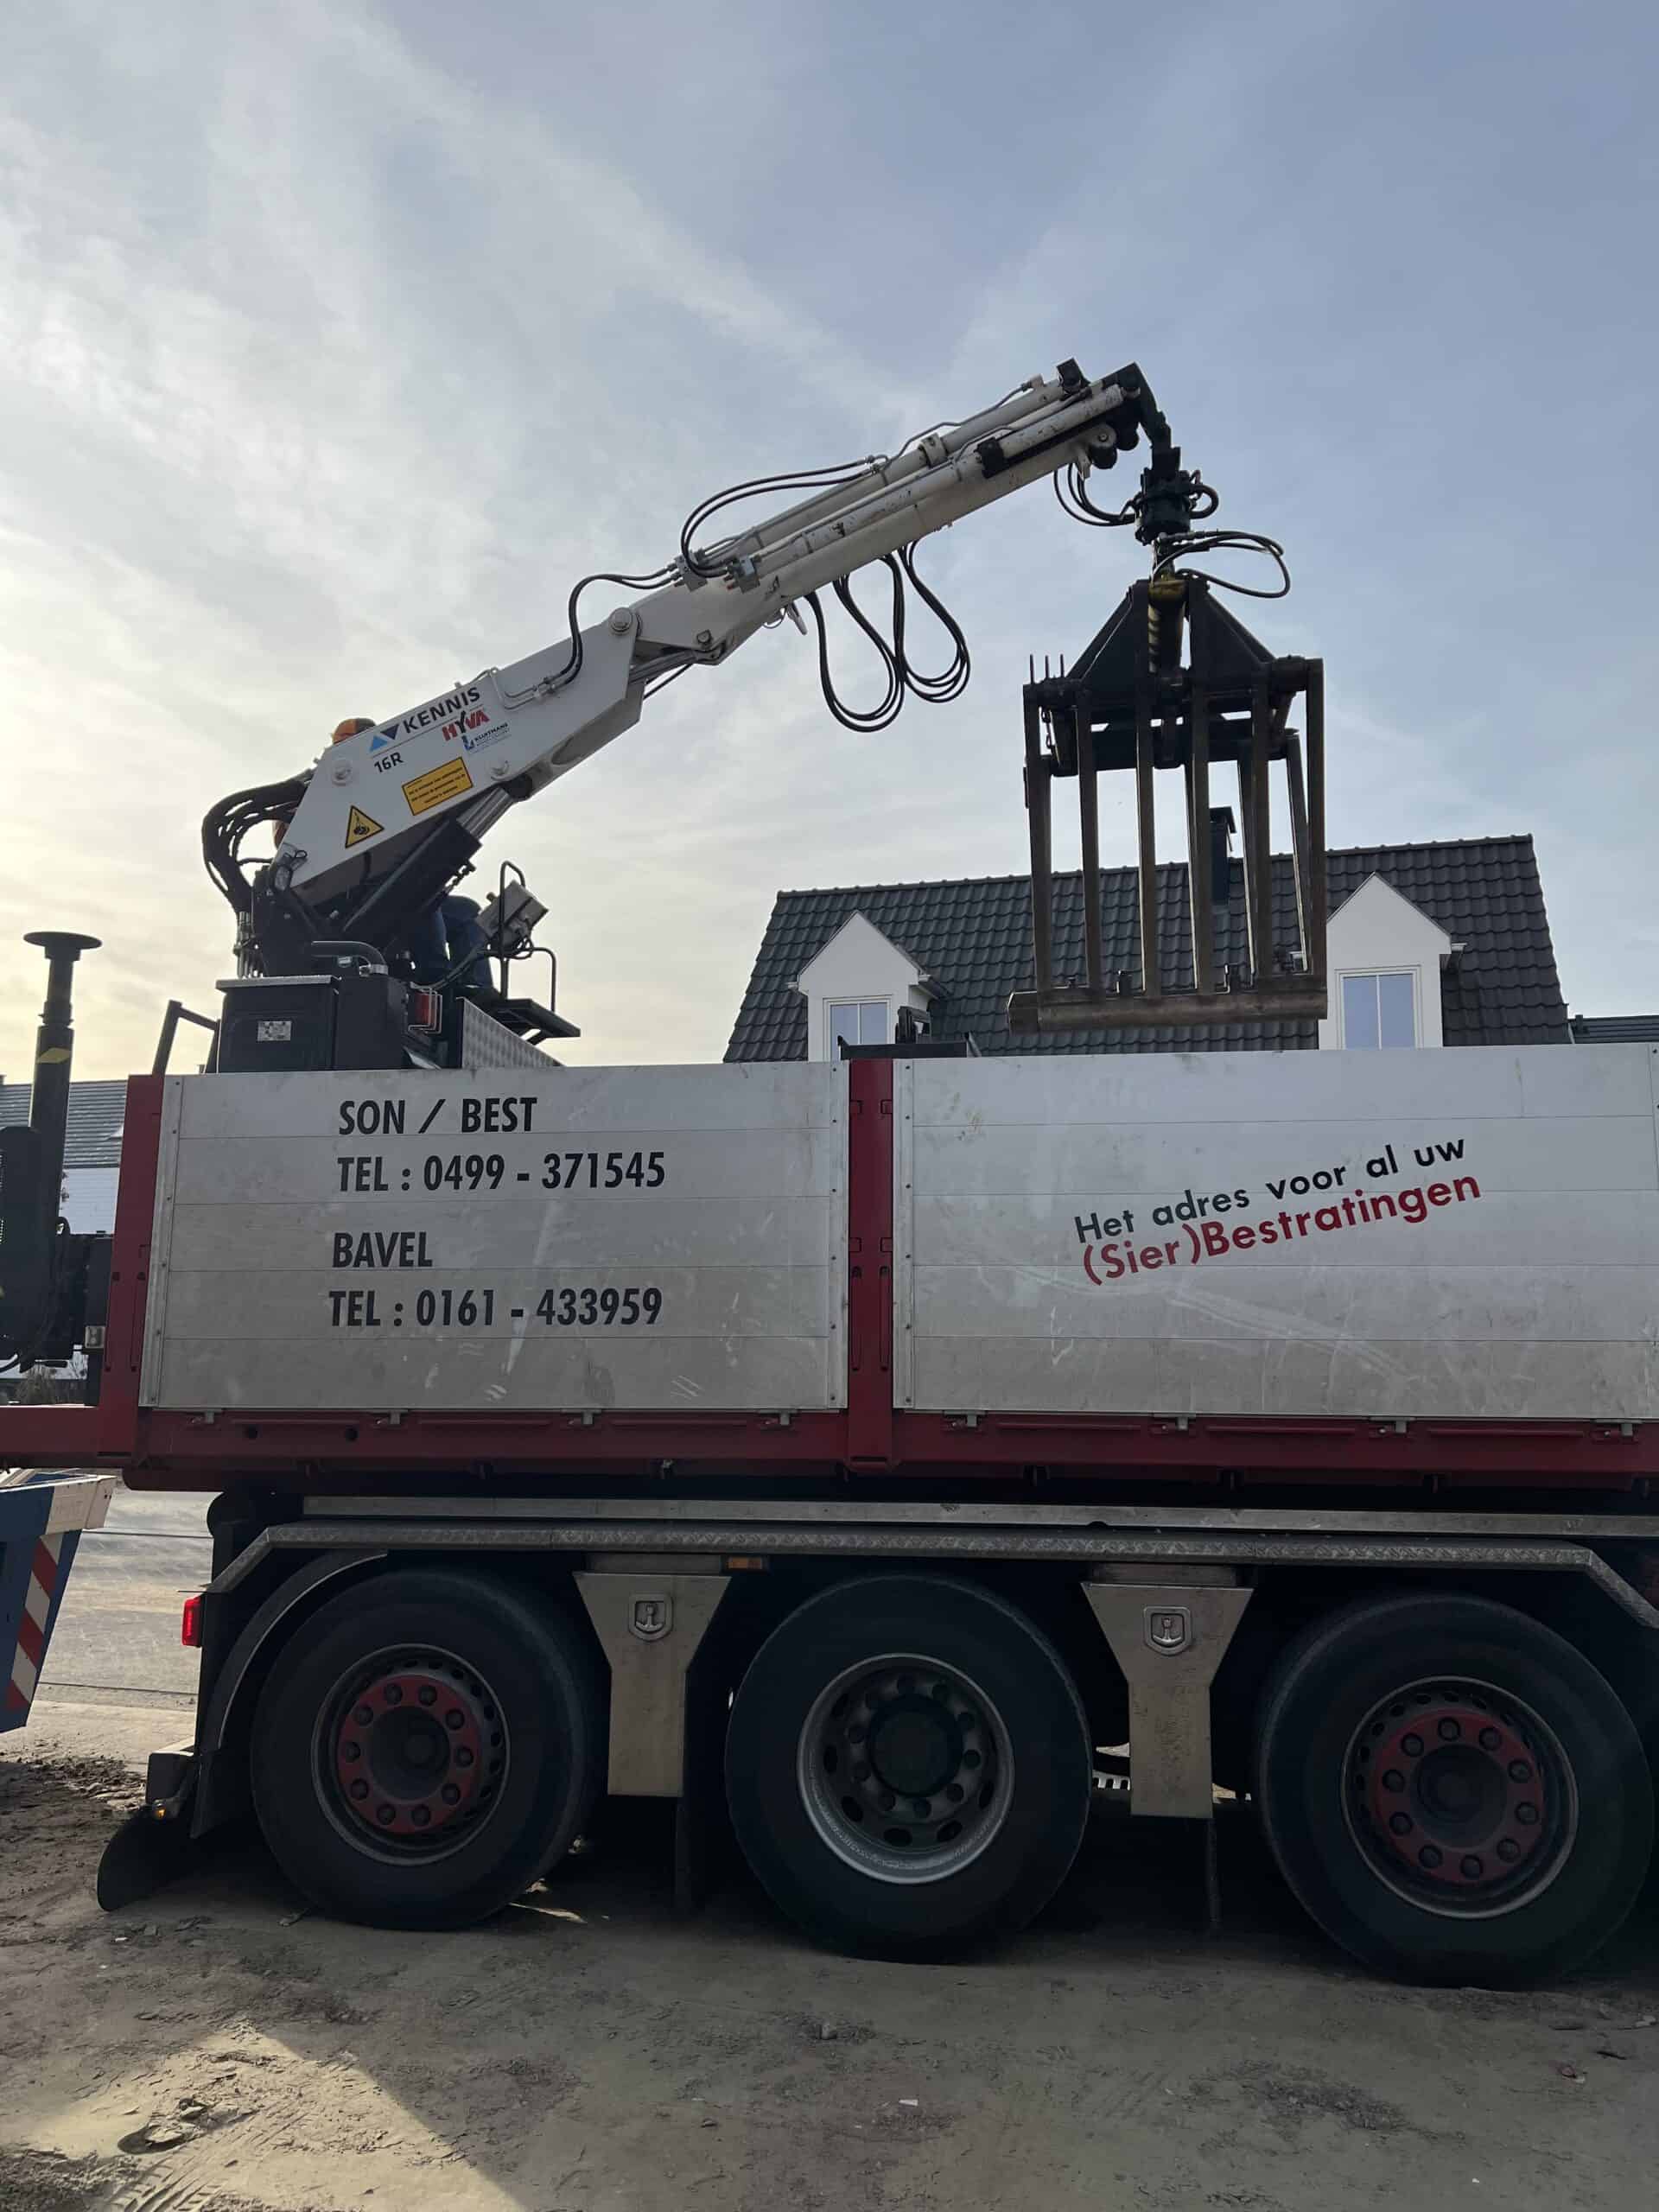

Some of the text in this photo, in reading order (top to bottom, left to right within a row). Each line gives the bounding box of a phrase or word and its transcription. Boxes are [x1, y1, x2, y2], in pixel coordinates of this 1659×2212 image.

[403, 686, 480, 734] KENNIS
[442, 710, 490, 741] HYVA
[373, 752, 404, 773] 16R
[339, 1096, 537, 1135] SON / BEST
[423, 1154, 505, 1191] 0499
[542, 1152, 665, 1189] 371545
[1074, 1139, 1465, 1243] Het adres voor al uw
[332, 1231, 432, 1268] BAVEL
[416, 1289, 493, 1326] 0161
[537, 1287, 662, 1325] 433959
